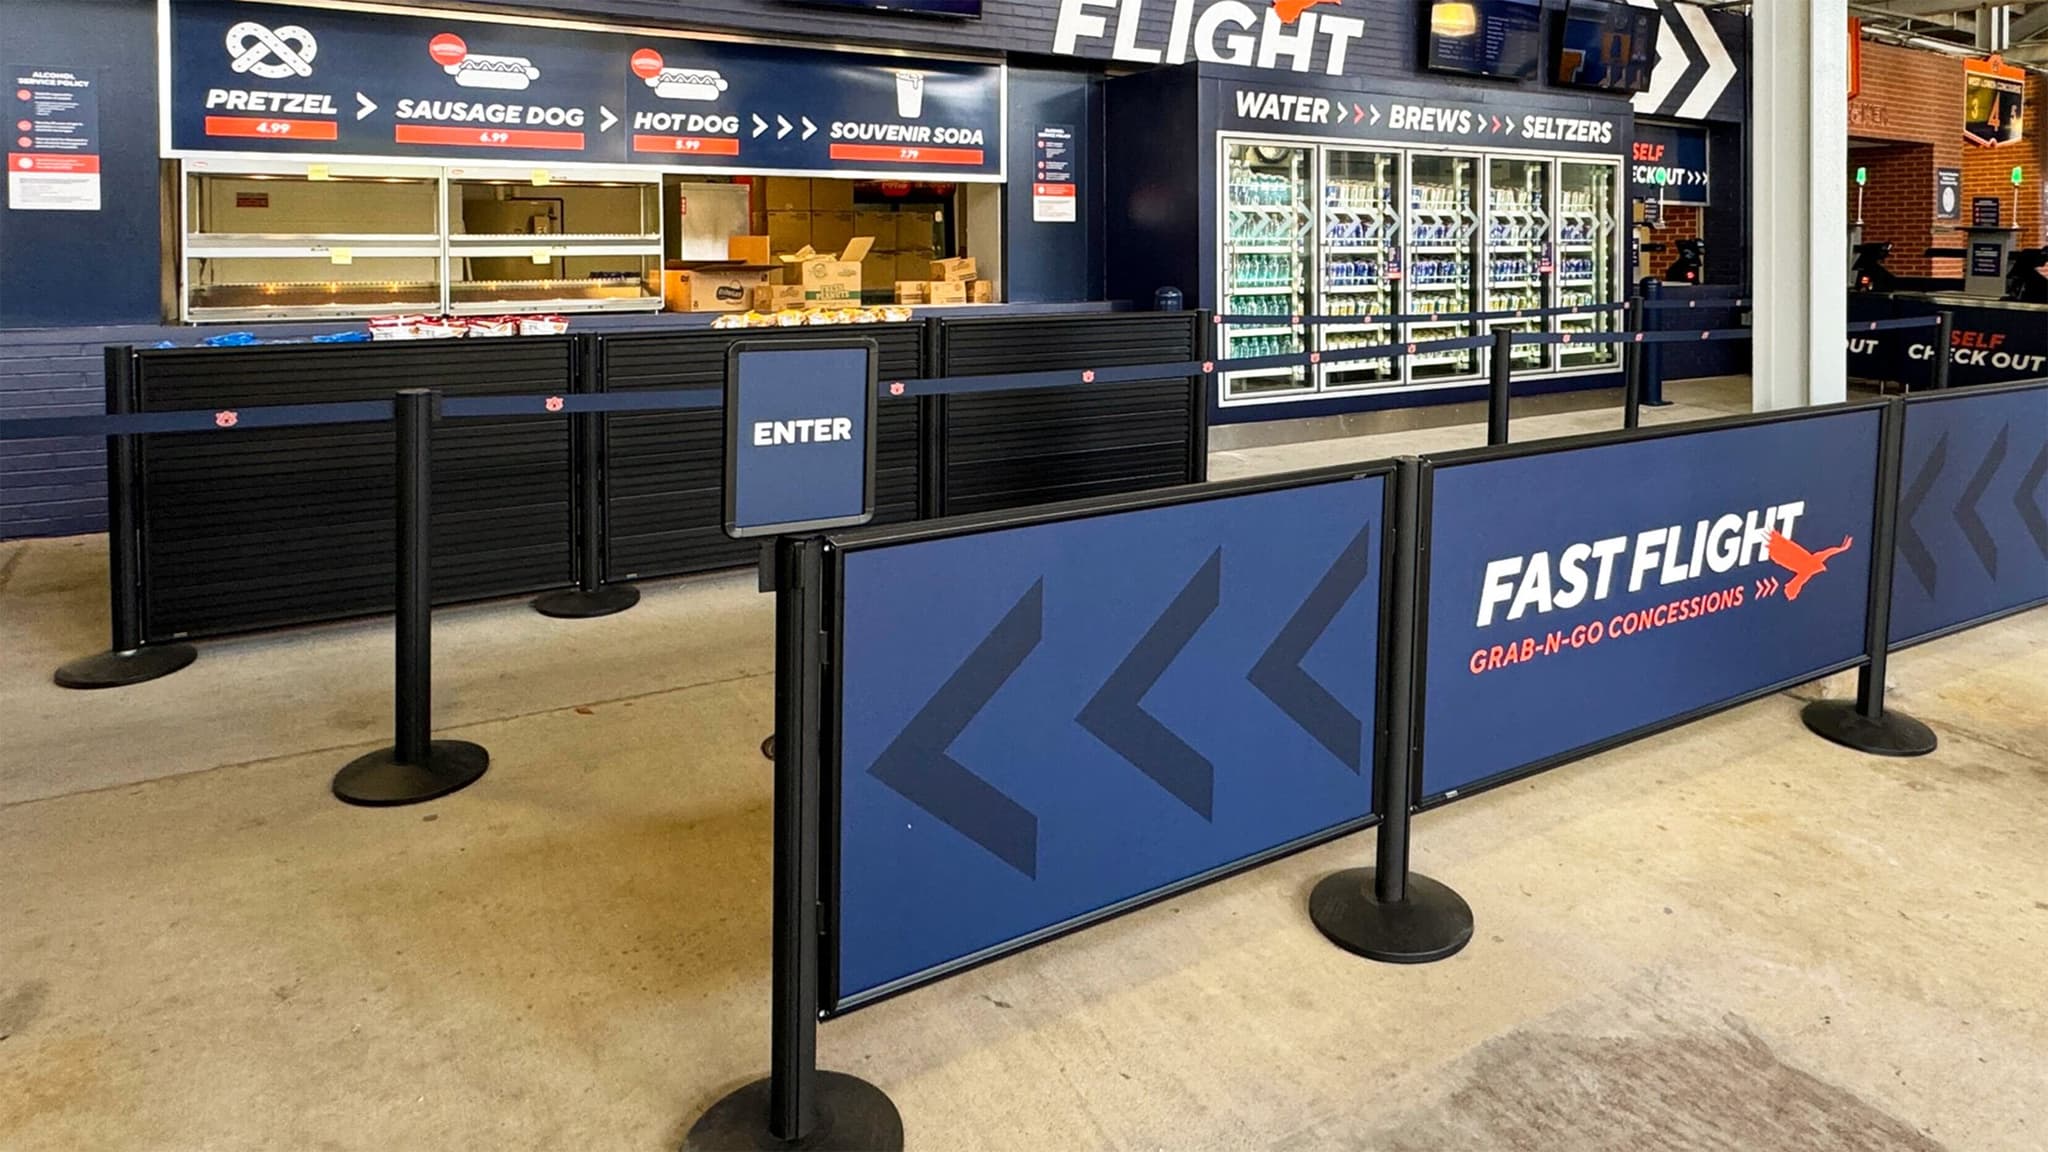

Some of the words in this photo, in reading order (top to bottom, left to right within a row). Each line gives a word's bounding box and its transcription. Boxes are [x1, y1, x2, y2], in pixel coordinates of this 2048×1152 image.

[1052, 0, 1365, 76] FLIGHT
[205, 89, 338, 115] PRETZEL
[395, 99, 523, 124] SAUSAGE
[526, 106, 585, 127] DOG
[256, 121, 290, 134] 4.99
[633, 112, 685, 131] HOT
[687, 115, 740, 134] DOG
[1236, 91, 1330, 124] WATER
[1388, 104, 1472, 134] BREWS
[1521, 115, 1613, 144] SELTZERS
[480, 131, 509, 143] 6.99
[830, 122, 930, 143] SOUVENIR
[932, 129, 984, 145] SODA
[1633, 142, 1665, 162] SELF
[1847, 338, 1879, 354] UT
[1951, 330, 2005, 349] SELF
[1991, 352, 2046, 372] OUT
[753, 418, 852, 446] ENTER
[1476, 536, 1627, 627] FAST
[1629, 500, 1804, 592] FLIGHT
[1469, 621, 1603, 674] GRAB-N-GO
[1608, 586, 1744, 640] CONCESSIONS
